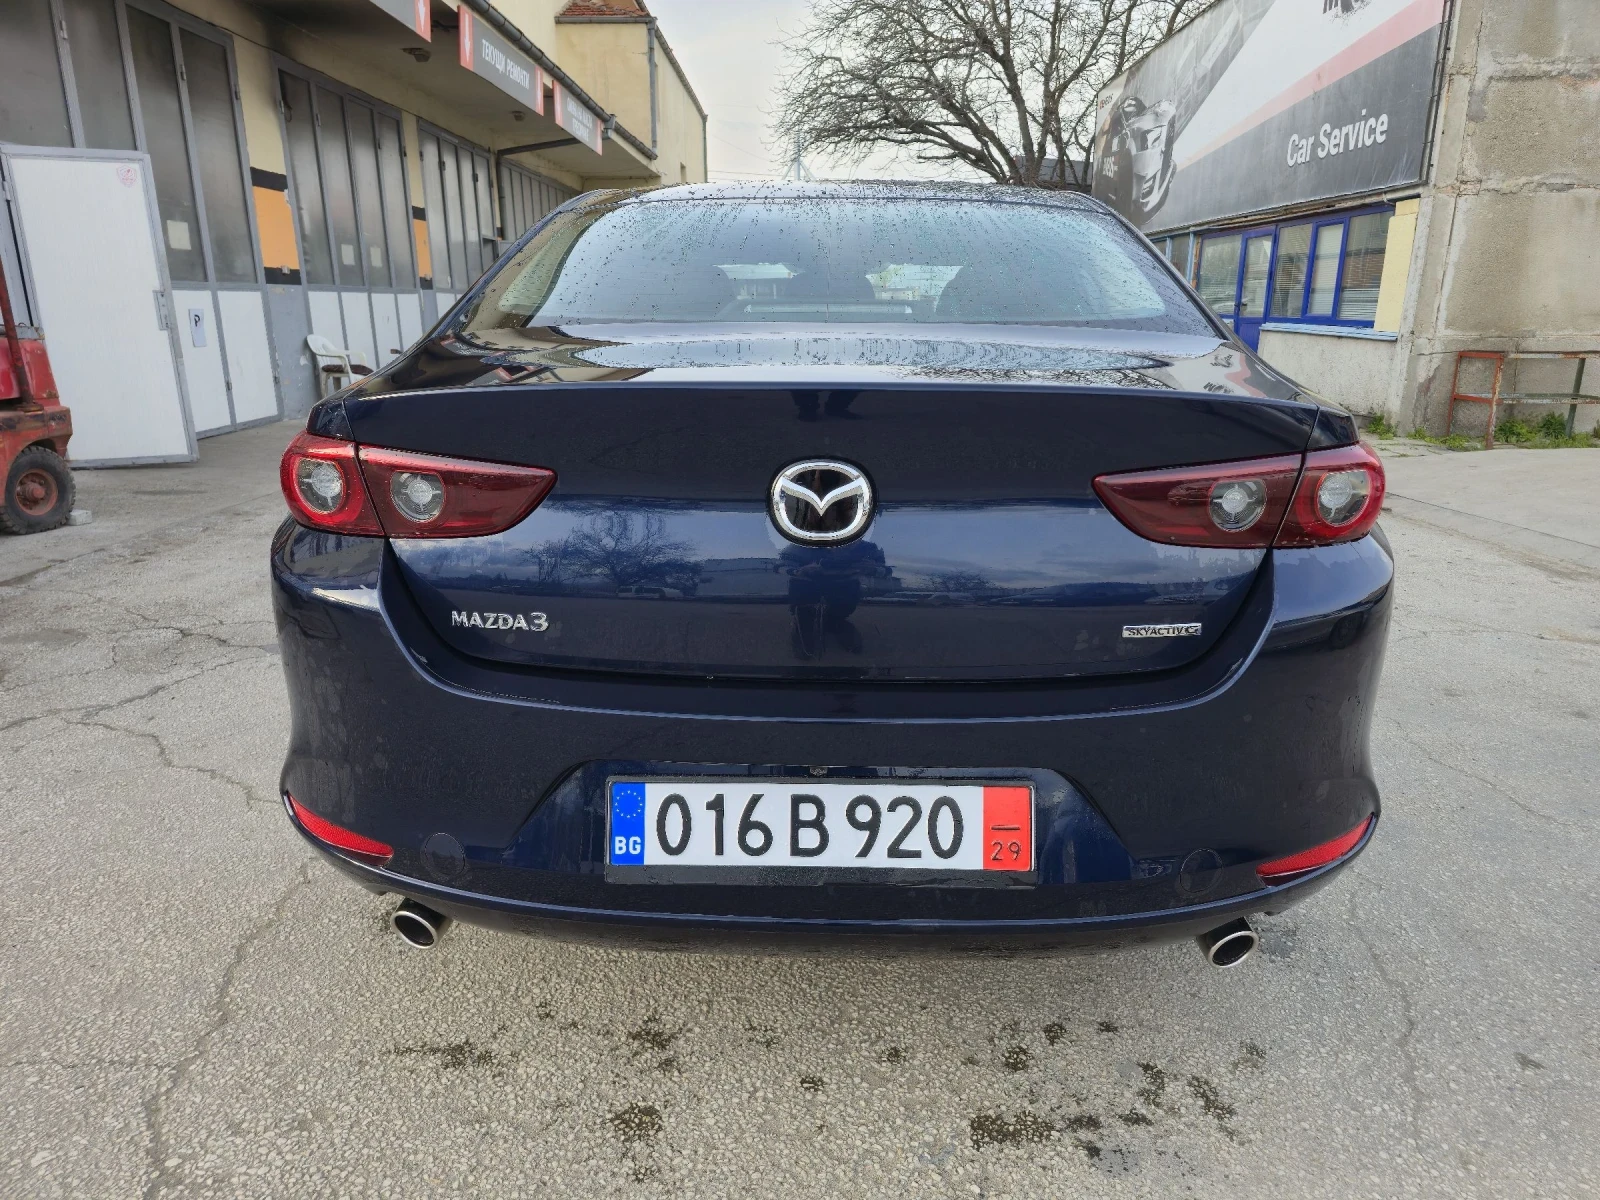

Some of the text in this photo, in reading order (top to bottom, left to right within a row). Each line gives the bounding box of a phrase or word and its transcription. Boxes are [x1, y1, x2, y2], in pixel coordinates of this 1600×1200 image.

[482, 38, 529, 89] ТЕКУЩИ РЕМОНТИ
[1287, 108, 1389, 167] Car Service
[451, 611, 549, 632] MAZDA3
[614, 836, 641, 855] BG
[991, 841, 1021, 861] 29
